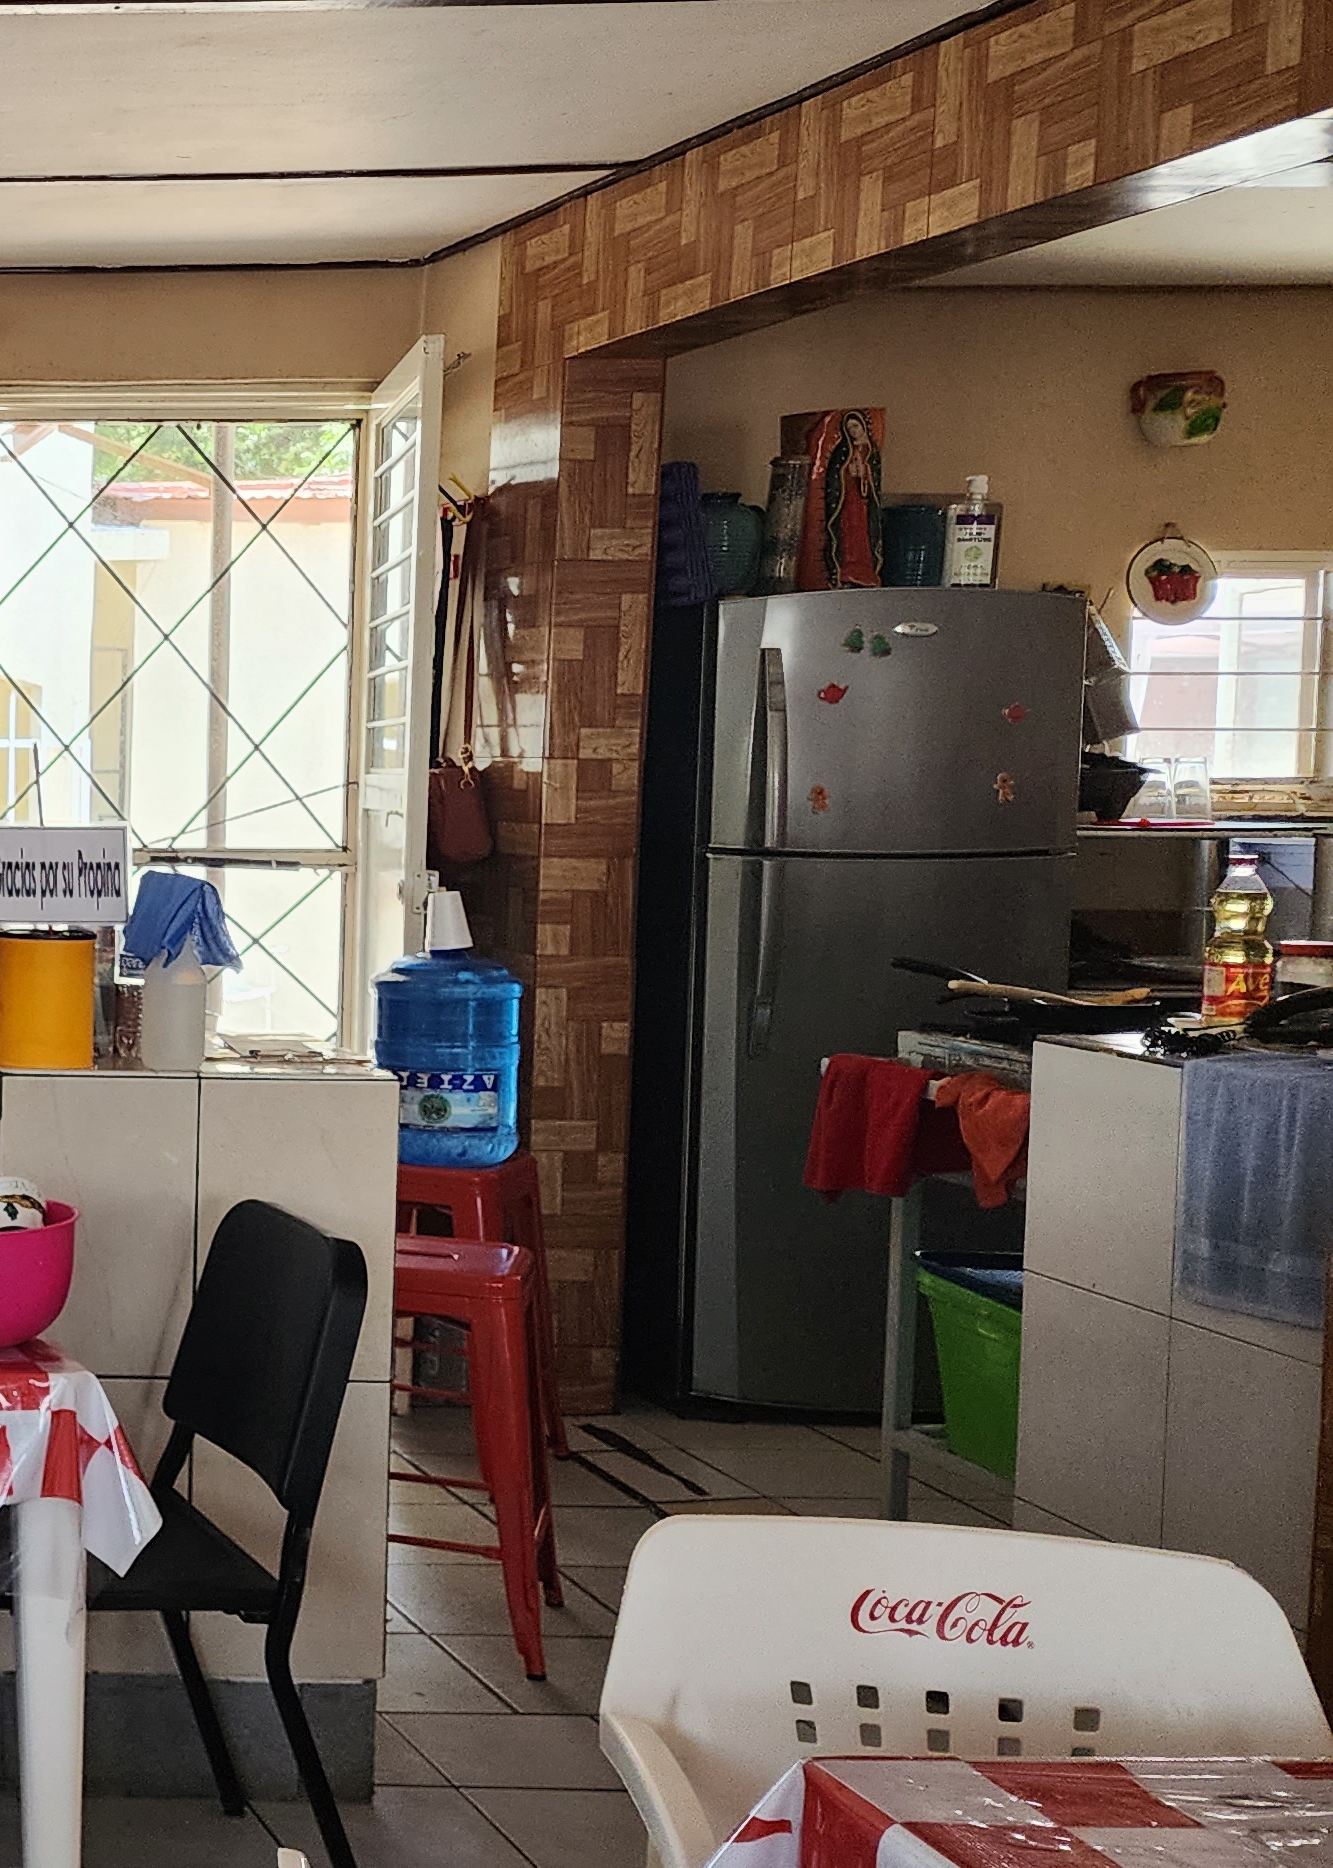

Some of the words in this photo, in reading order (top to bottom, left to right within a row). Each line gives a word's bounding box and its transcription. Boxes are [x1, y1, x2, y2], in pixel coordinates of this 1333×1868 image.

[40, 861, 59, 911] por
[62, 861, 74, 898] su
[77, 848, 122, 911] Propina
[850, 1587, 1032, 1649] Coca-Cola
